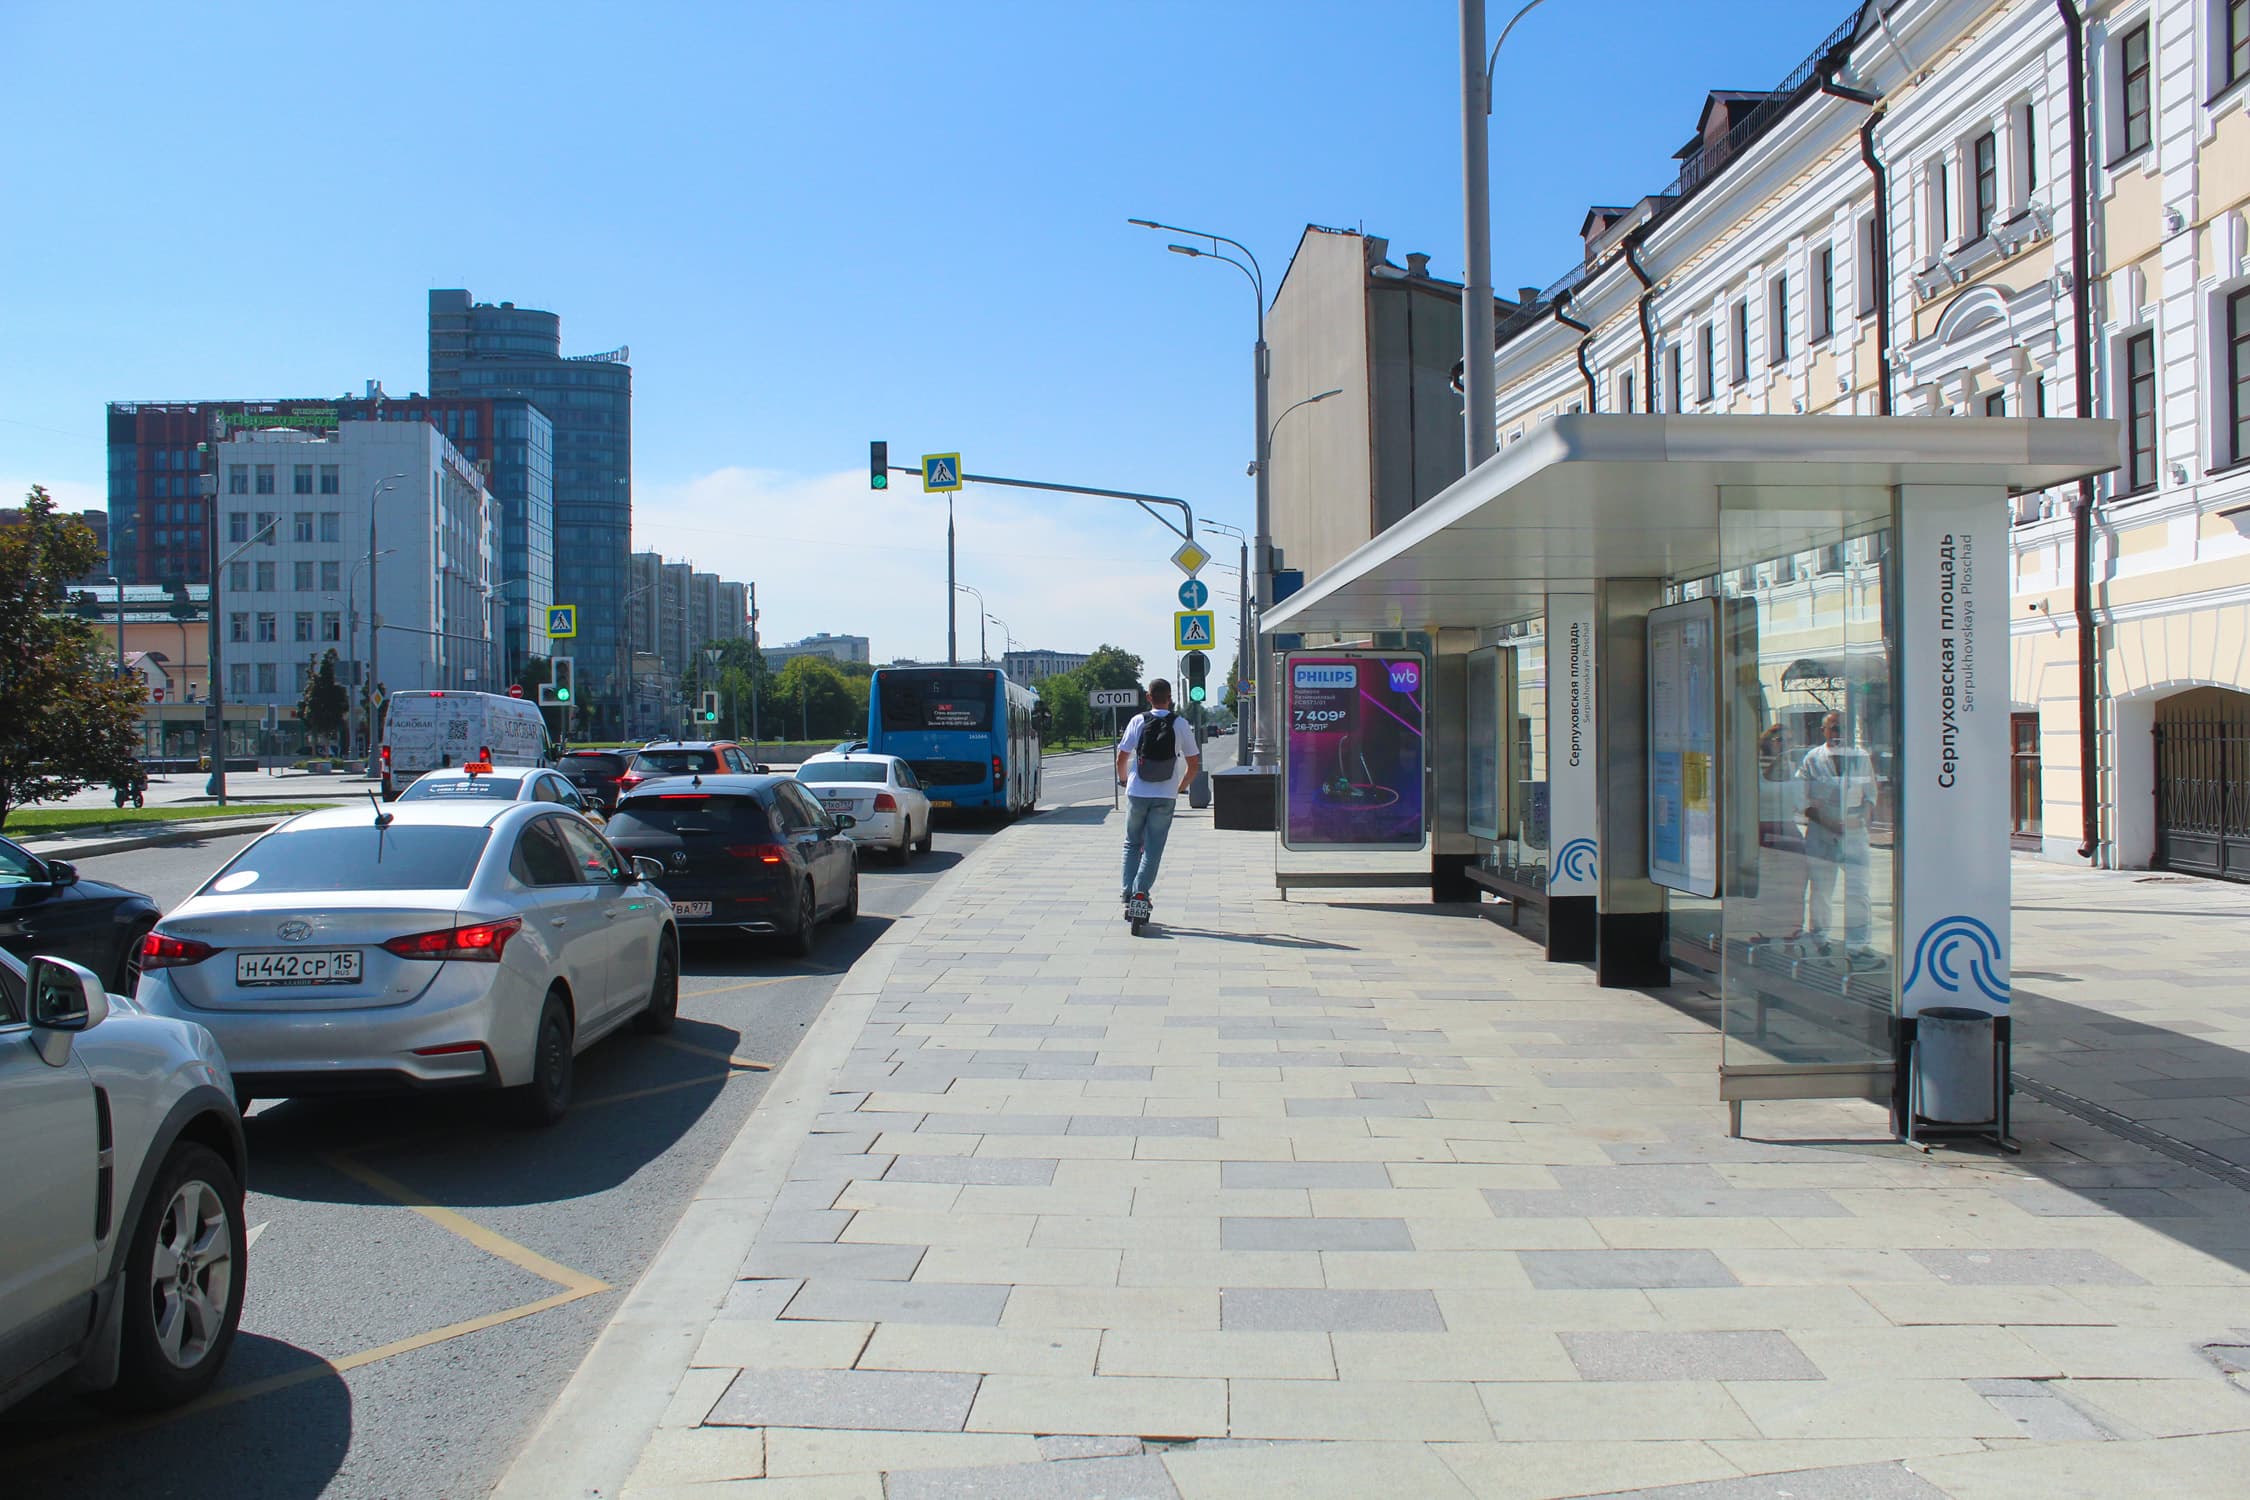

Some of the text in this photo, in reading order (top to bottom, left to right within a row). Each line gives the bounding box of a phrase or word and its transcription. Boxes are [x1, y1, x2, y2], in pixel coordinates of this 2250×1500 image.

[1960, 534, 1976, 712] Serpukhovskaya Ploschad
[1938, 534, 1959, 788] Серпуховская площадь
[1297, 671, 1353, 683] PHILIPS
[1391, 668, 1417, 684] wb
[1097, 692, 1131, 704] СТОП
[1569, 622, 1583, 767] Серпуховская площадь
[334, 954, 353, 970] 15
